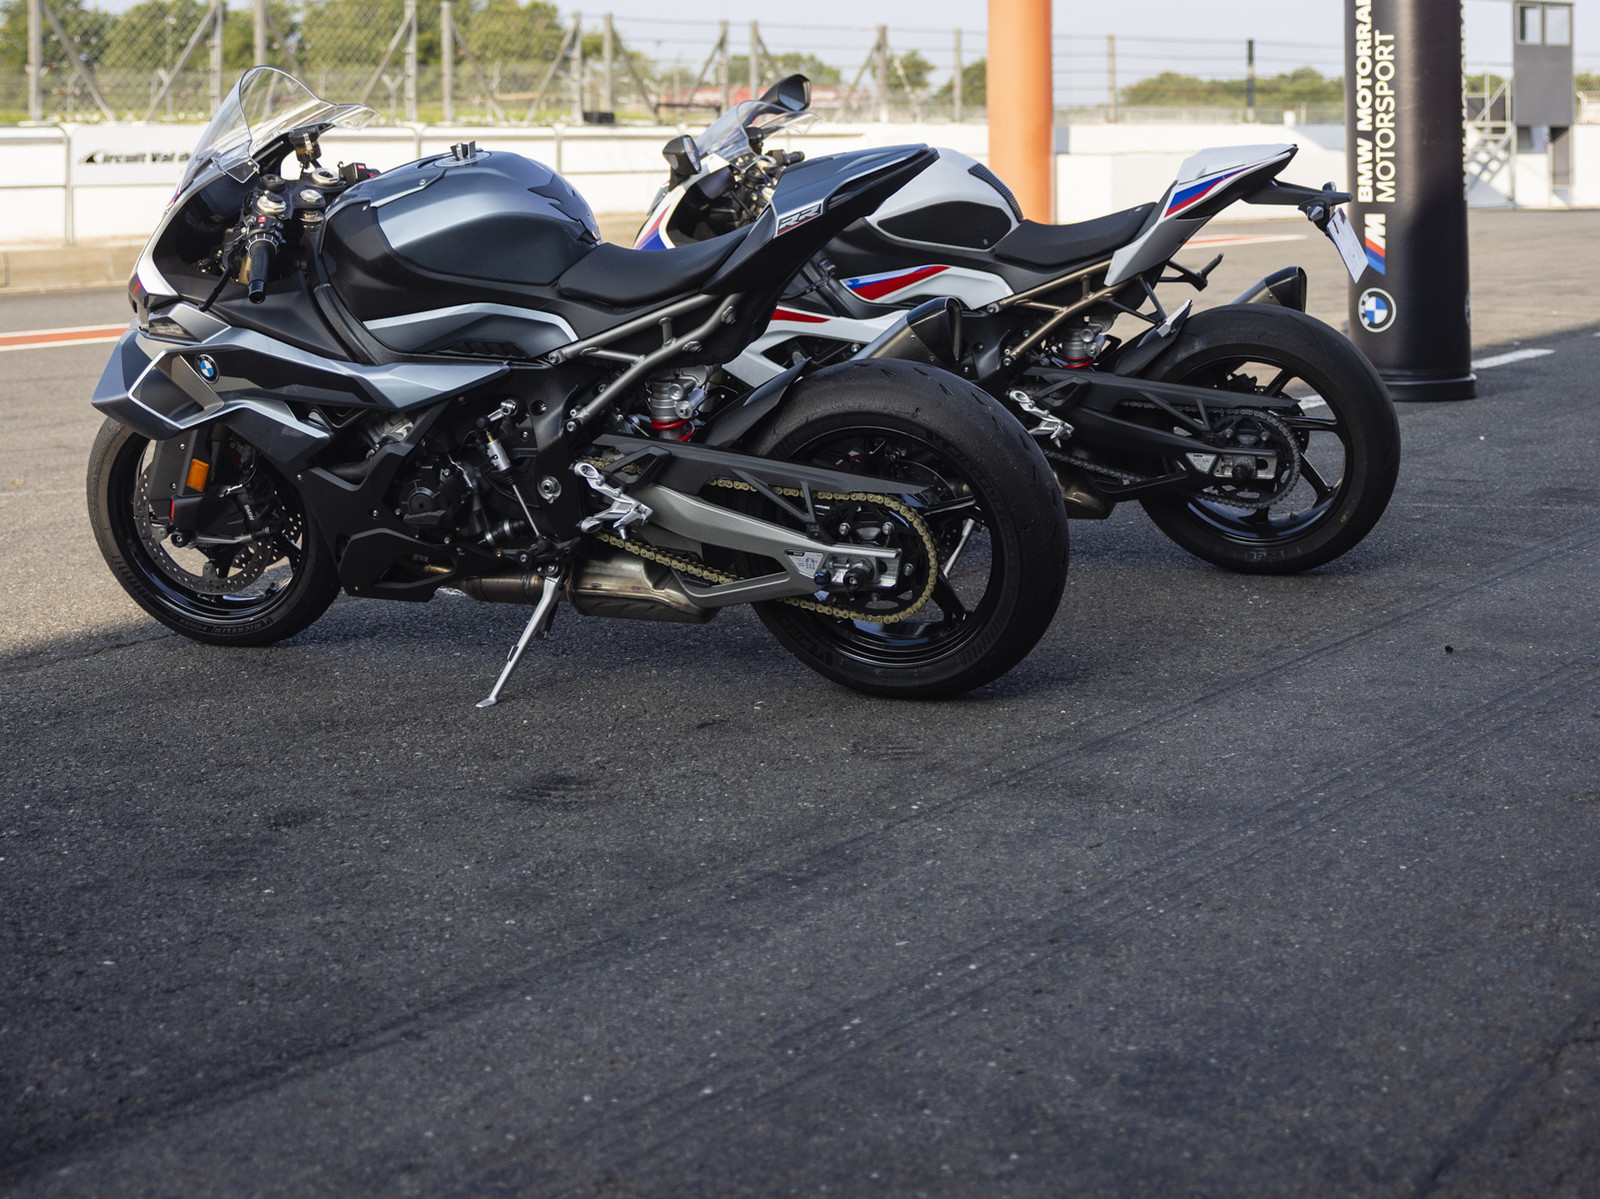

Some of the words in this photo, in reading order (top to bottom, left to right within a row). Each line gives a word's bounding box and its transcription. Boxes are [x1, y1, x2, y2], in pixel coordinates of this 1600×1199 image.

[1374, 29, 1396, 203] MOTORSPORT
[151, 152, 175, 164] Val
[178, 152, 191, 163] d
[1357, 137, 1373, 203] BMW
[779, 204, 820, 229] RR
[243, 504, 255, 521] BMW
[178, 616, 208, 631] POWER
[214, 622, 262, 634] MICHELIN
